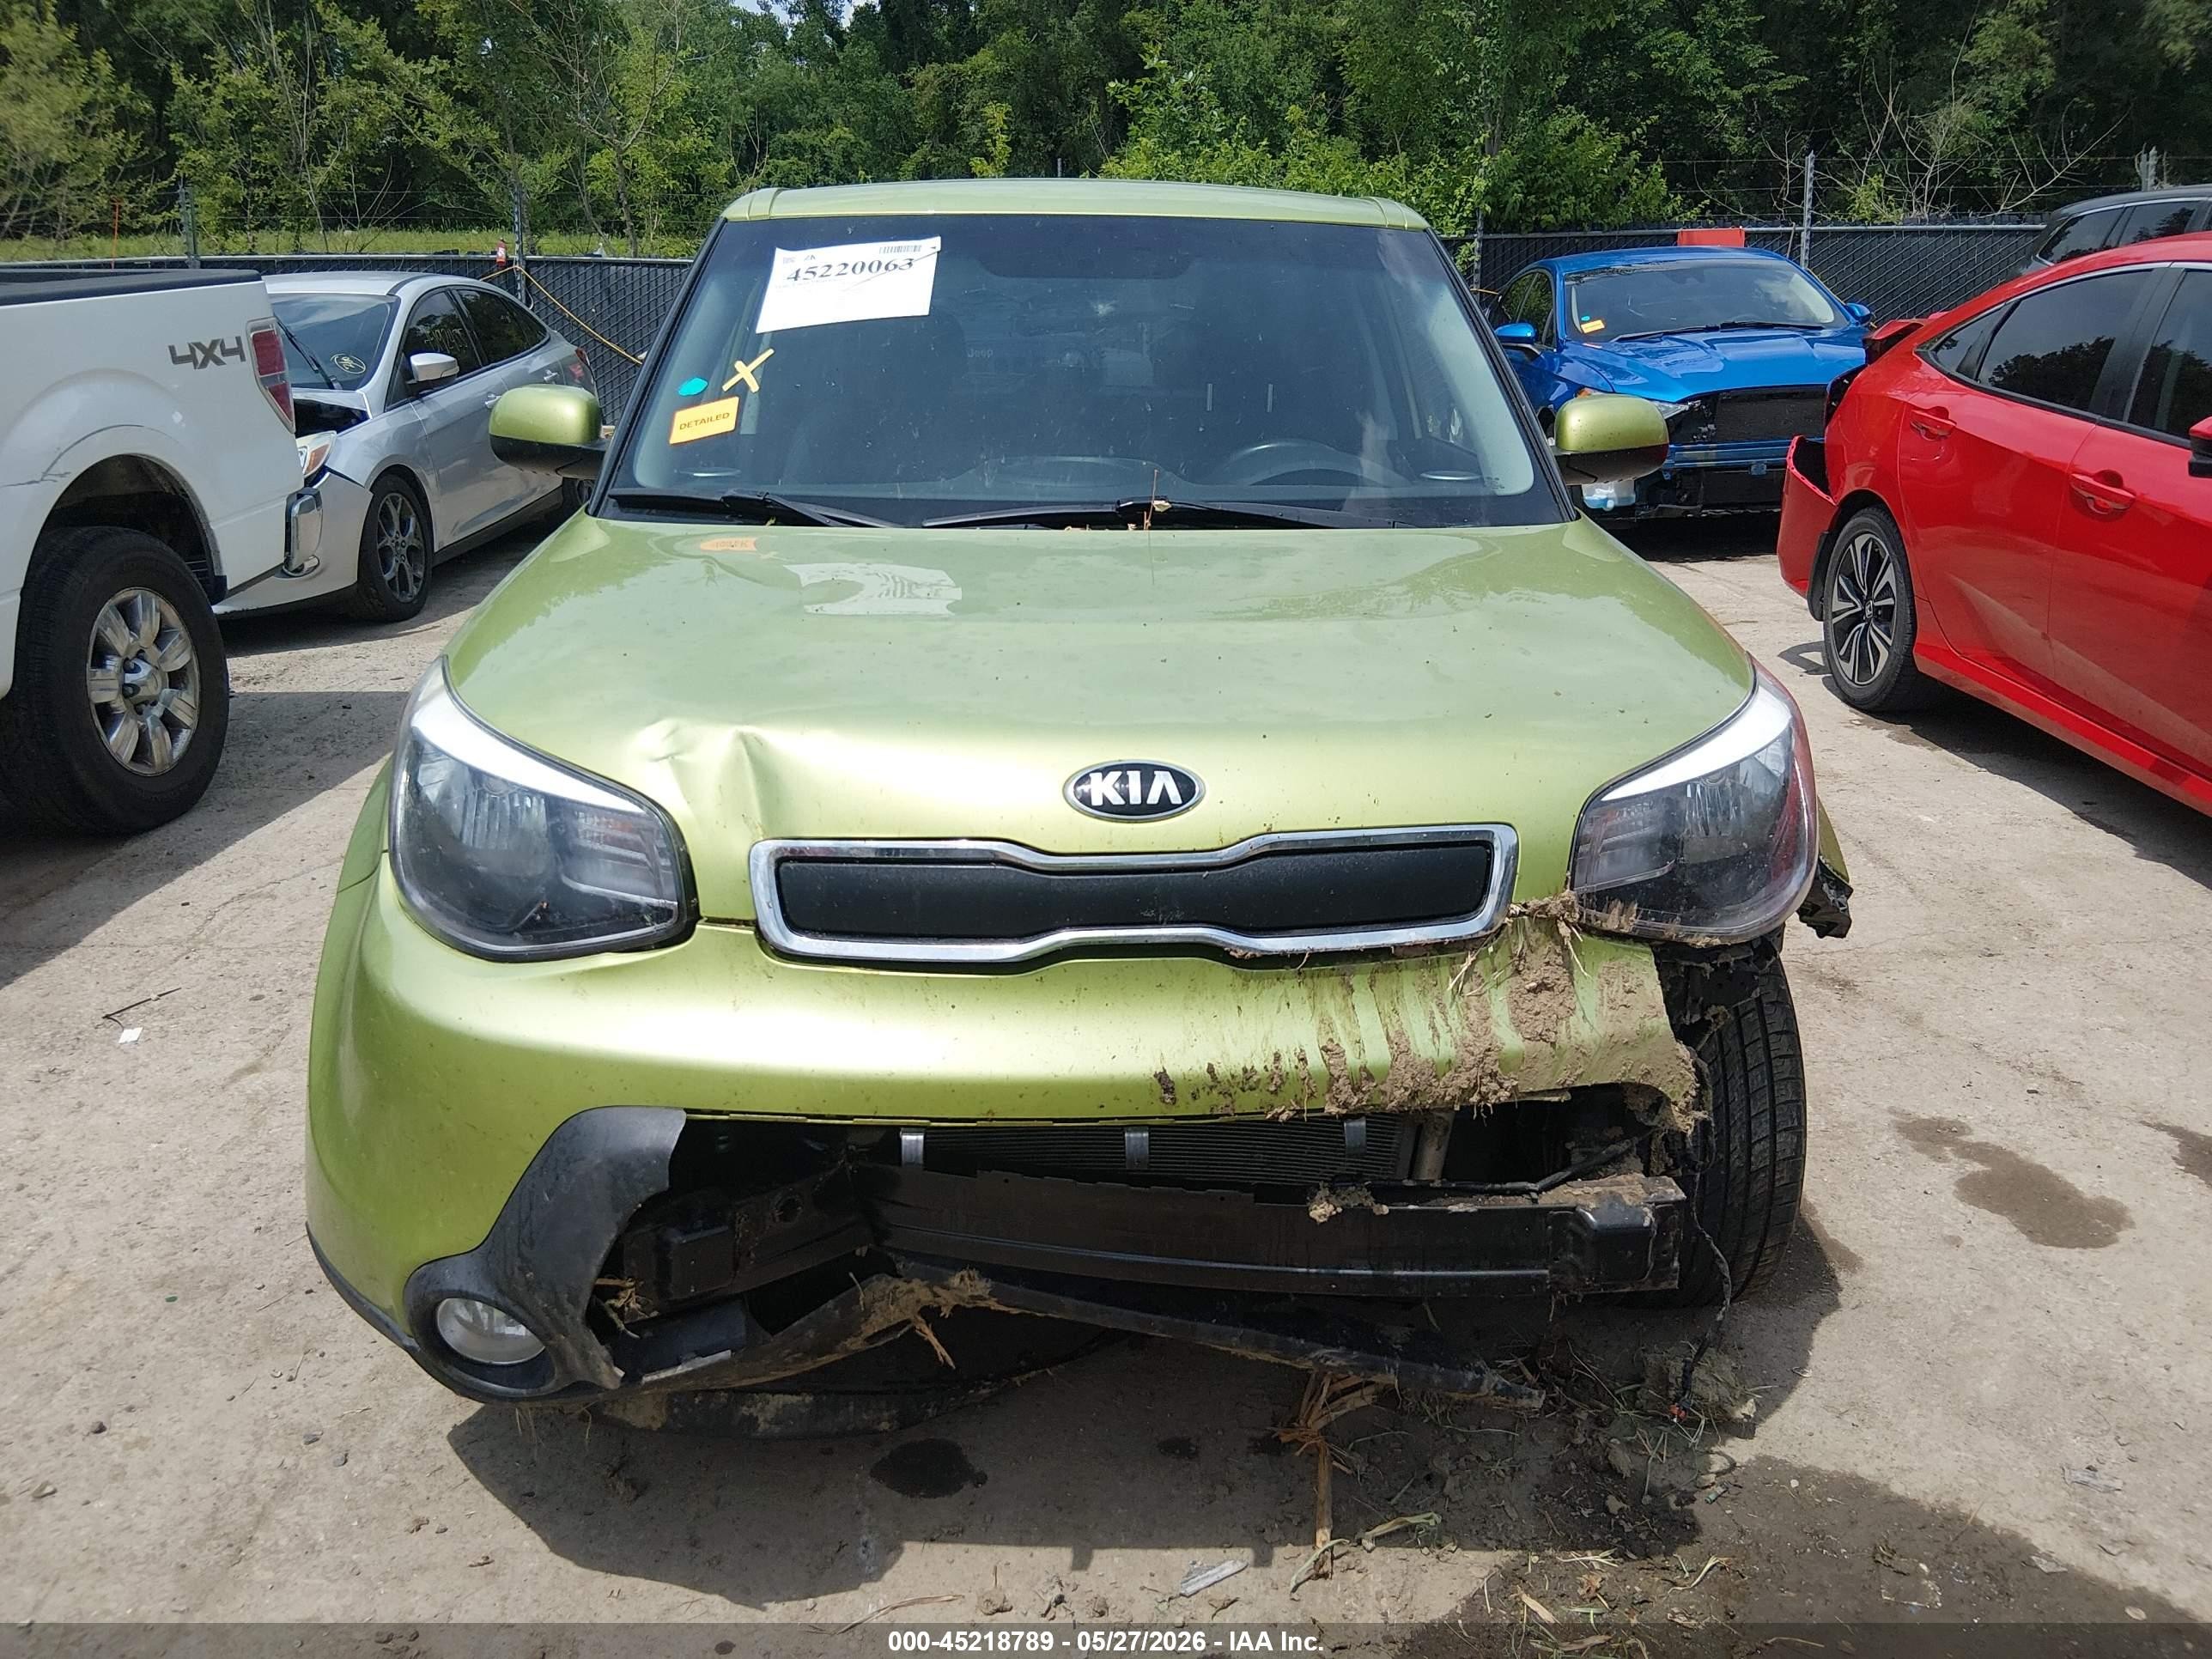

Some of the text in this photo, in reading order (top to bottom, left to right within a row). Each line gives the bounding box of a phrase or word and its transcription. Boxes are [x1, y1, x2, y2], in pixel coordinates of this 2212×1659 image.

[786, 258, 915, 282] 45220063
[167, 335, 246, 369] 4X4
[678, 411, 731, 431] DETAILED
[1088, 769, 1183, 806] KIA
